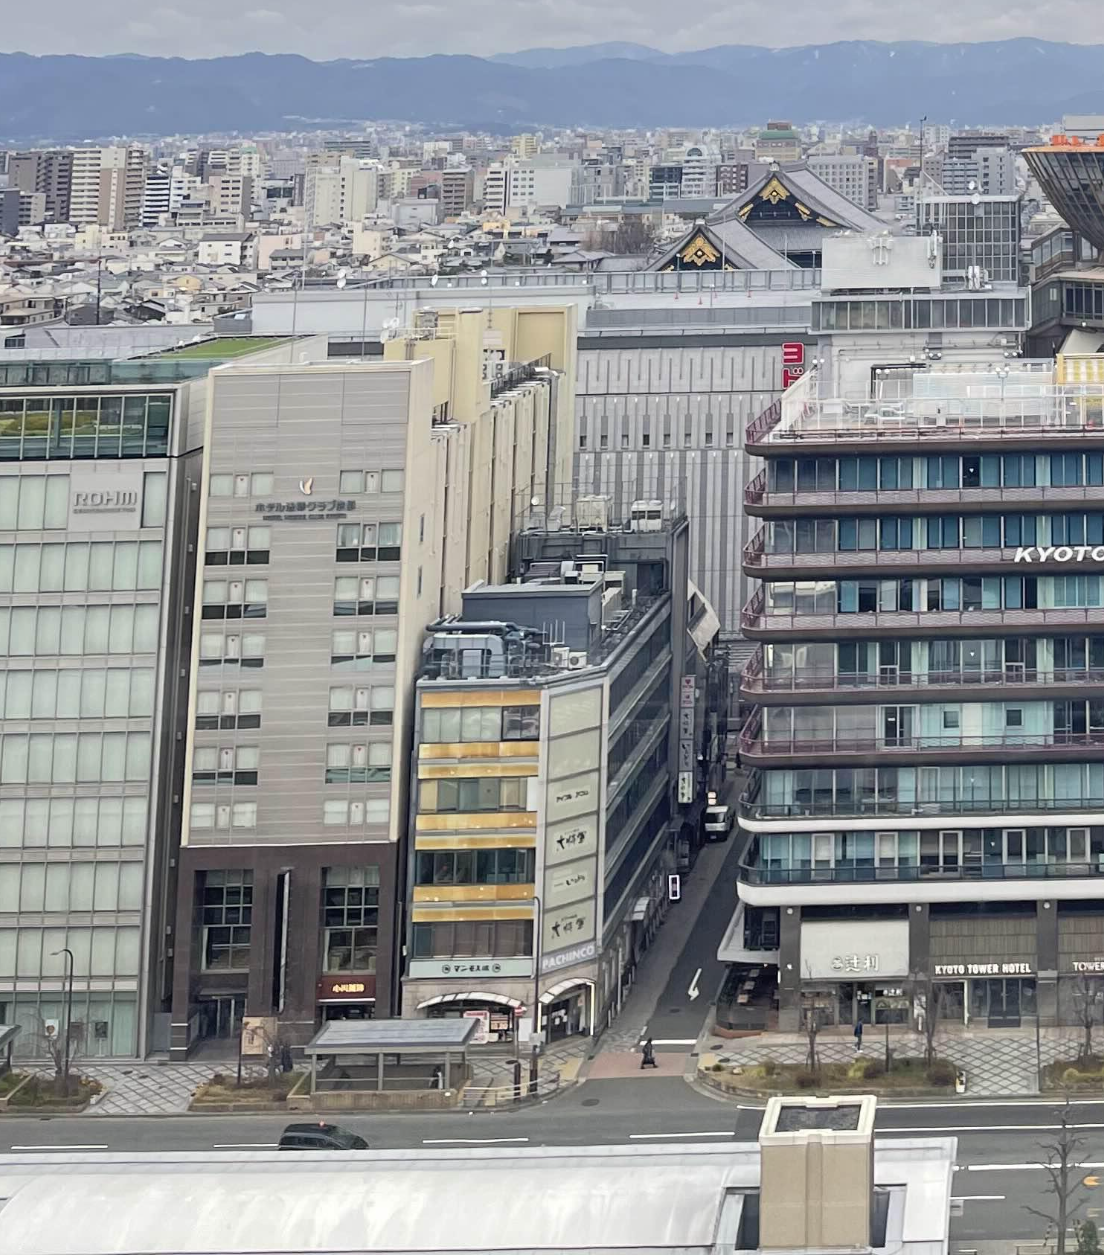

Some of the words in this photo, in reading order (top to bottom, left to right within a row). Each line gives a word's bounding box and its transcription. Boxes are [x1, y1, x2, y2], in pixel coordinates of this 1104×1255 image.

[73, 491, 138, 506] ROHM
[542, 946, 595, 969] PACHINCO
[843, 954, 880, 972] 辻利
[934, 964, 965, 975] KYOTO
[966, 963, 999, 975] TOWER
[1001, 962, 1032, 974] HOTEL
